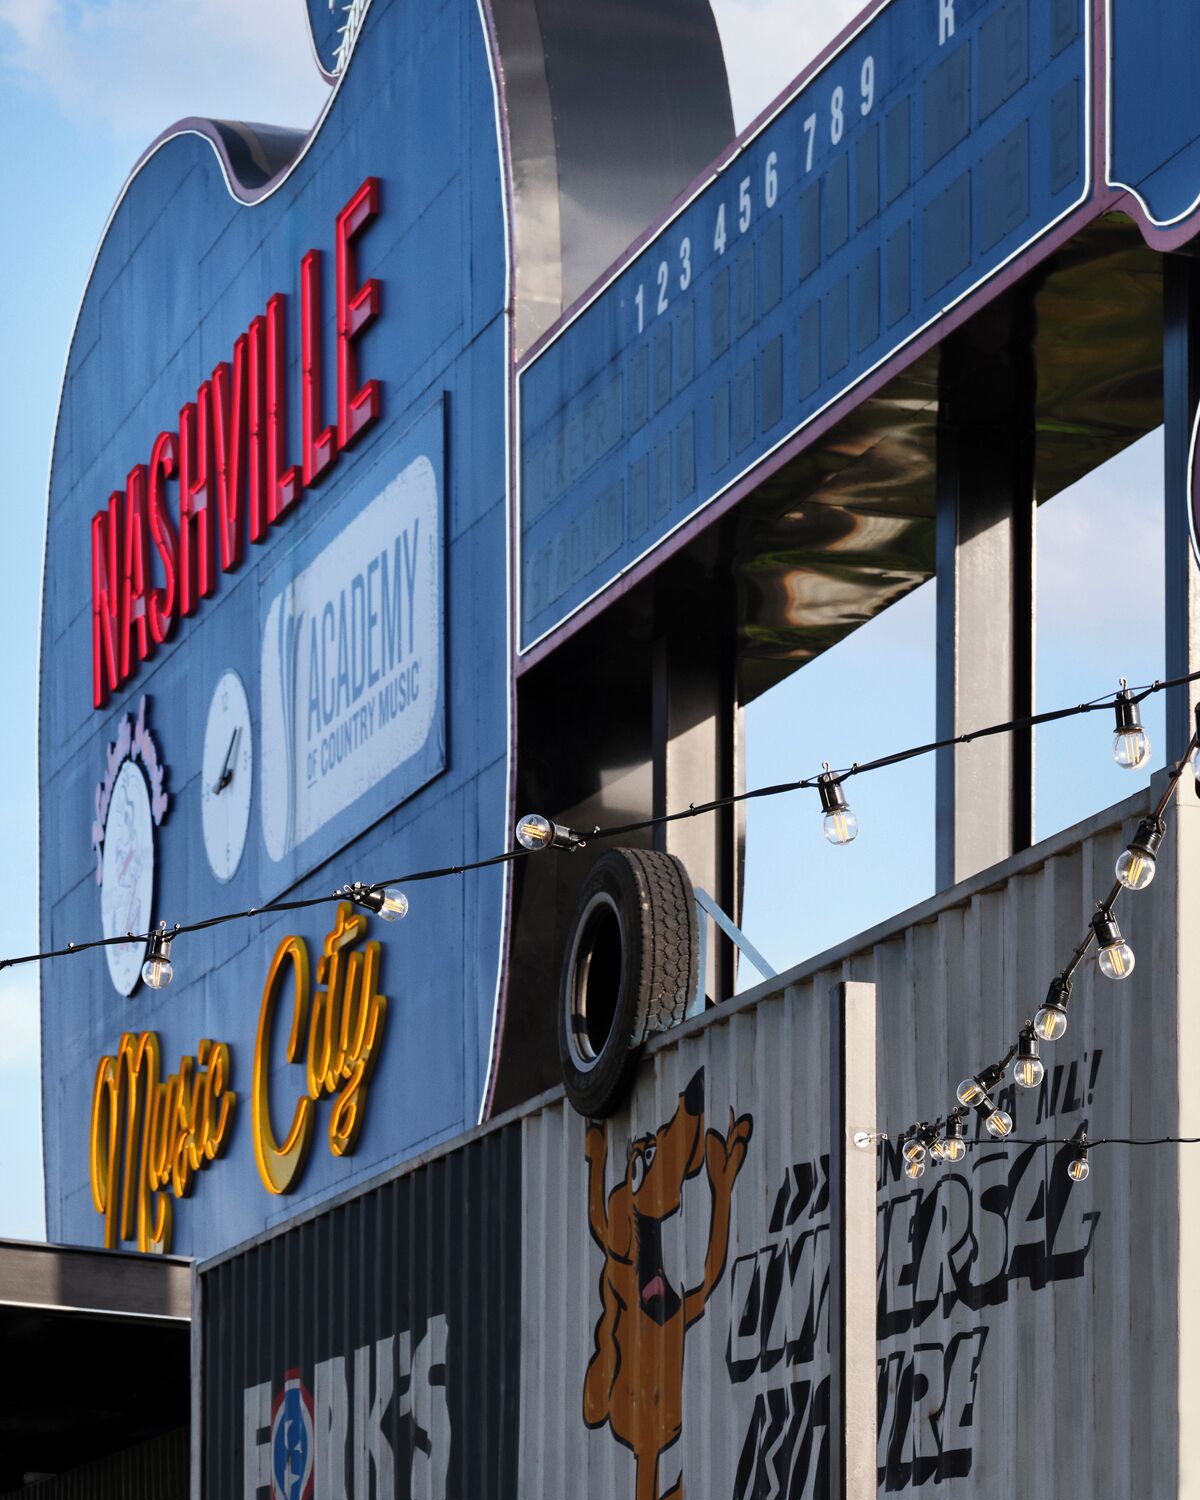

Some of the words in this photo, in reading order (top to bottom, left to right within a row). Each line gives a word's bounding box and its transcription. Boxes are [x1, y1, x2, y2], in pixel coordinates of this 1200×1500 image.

[92, 176, 381, 711] NASHVILLE
[307, 517, 420, 742] ACADEMY
[307, 748, 318, 789] OF
[320, 706, 375, 777] COUNTRY
[379, 659, 421, 728] MUSIC
[89, 1031, 237, 1254] Music
[252, 902, 387, 1195] City
